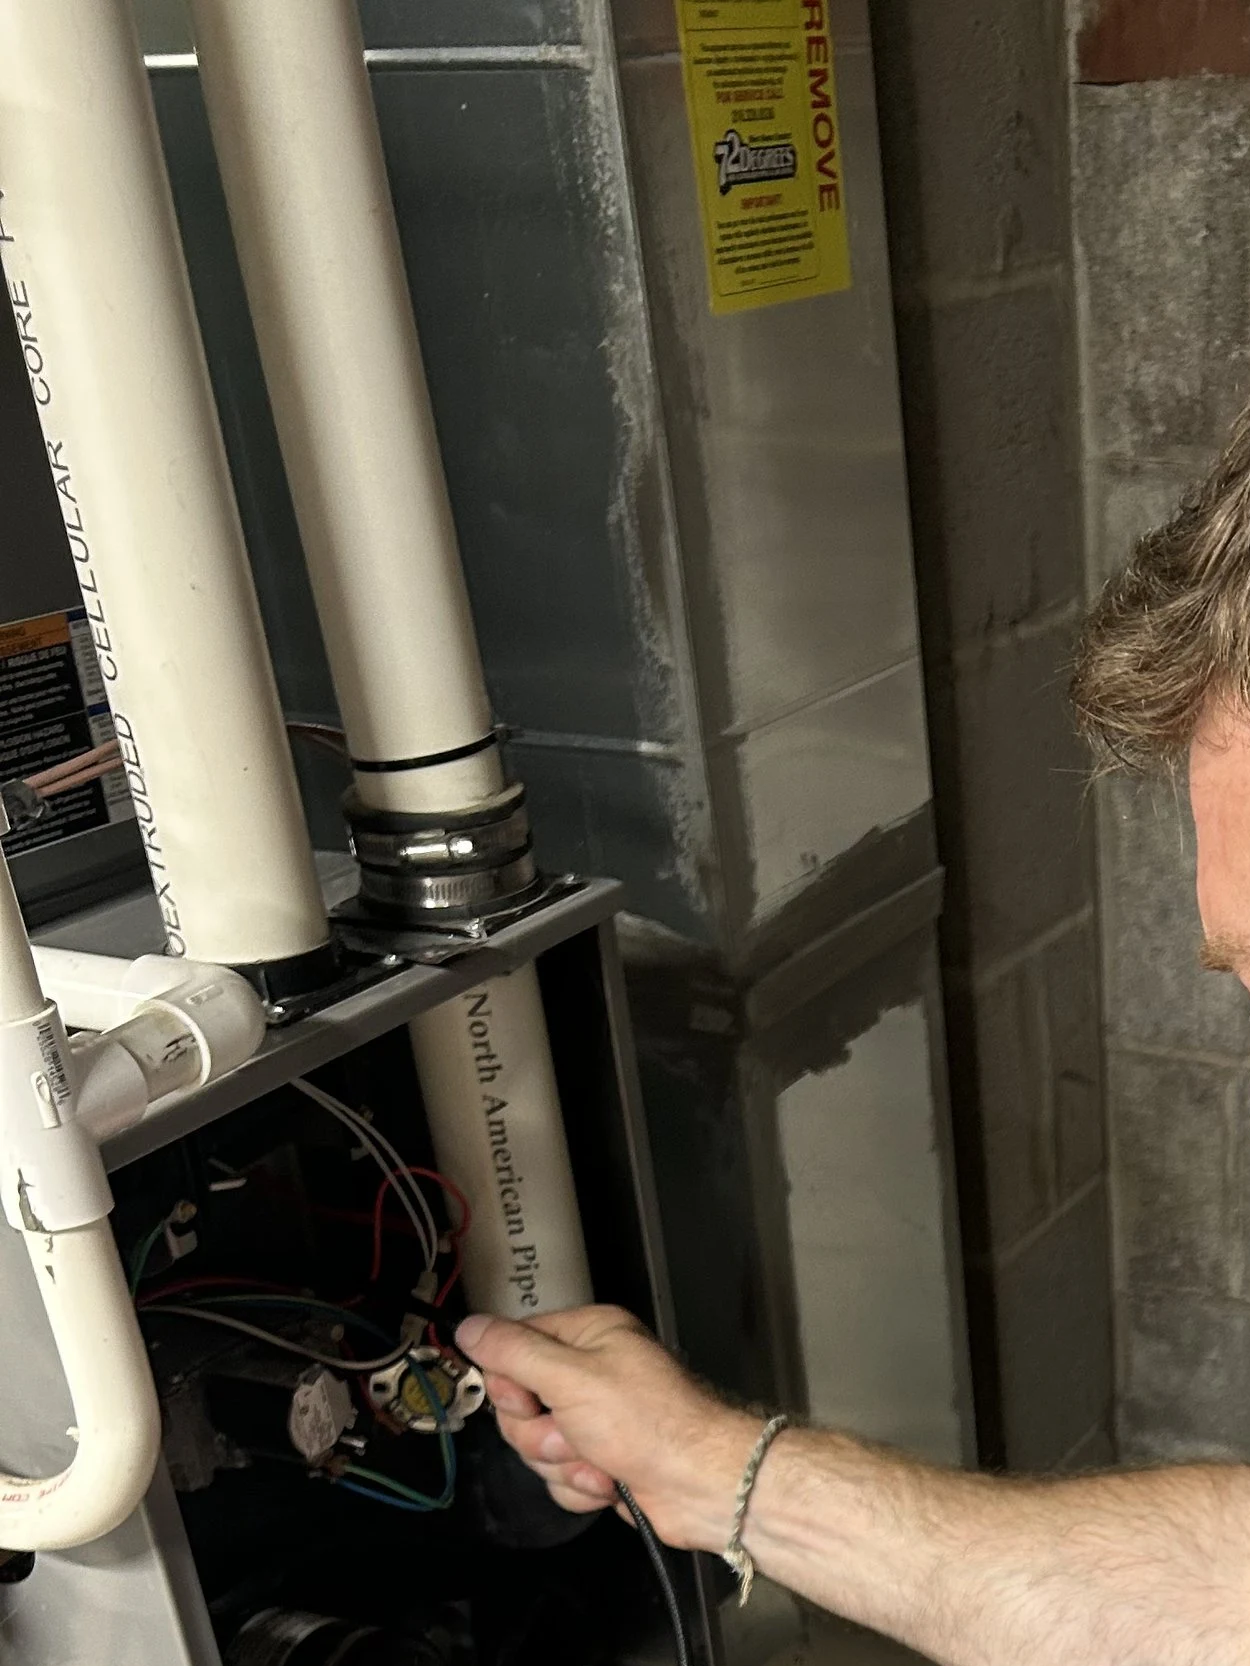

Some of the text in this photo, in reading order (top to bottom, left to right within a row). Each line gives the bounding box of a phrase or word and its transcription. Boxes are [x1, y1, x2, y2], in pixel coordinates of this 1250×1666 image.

[801, 0, 842, 212] REMOVE
[9, 280, 51, 406] CORE
[47, 440, 118, 681] CELLULAR
[463, 993, 540, 1308] North American Pipe
